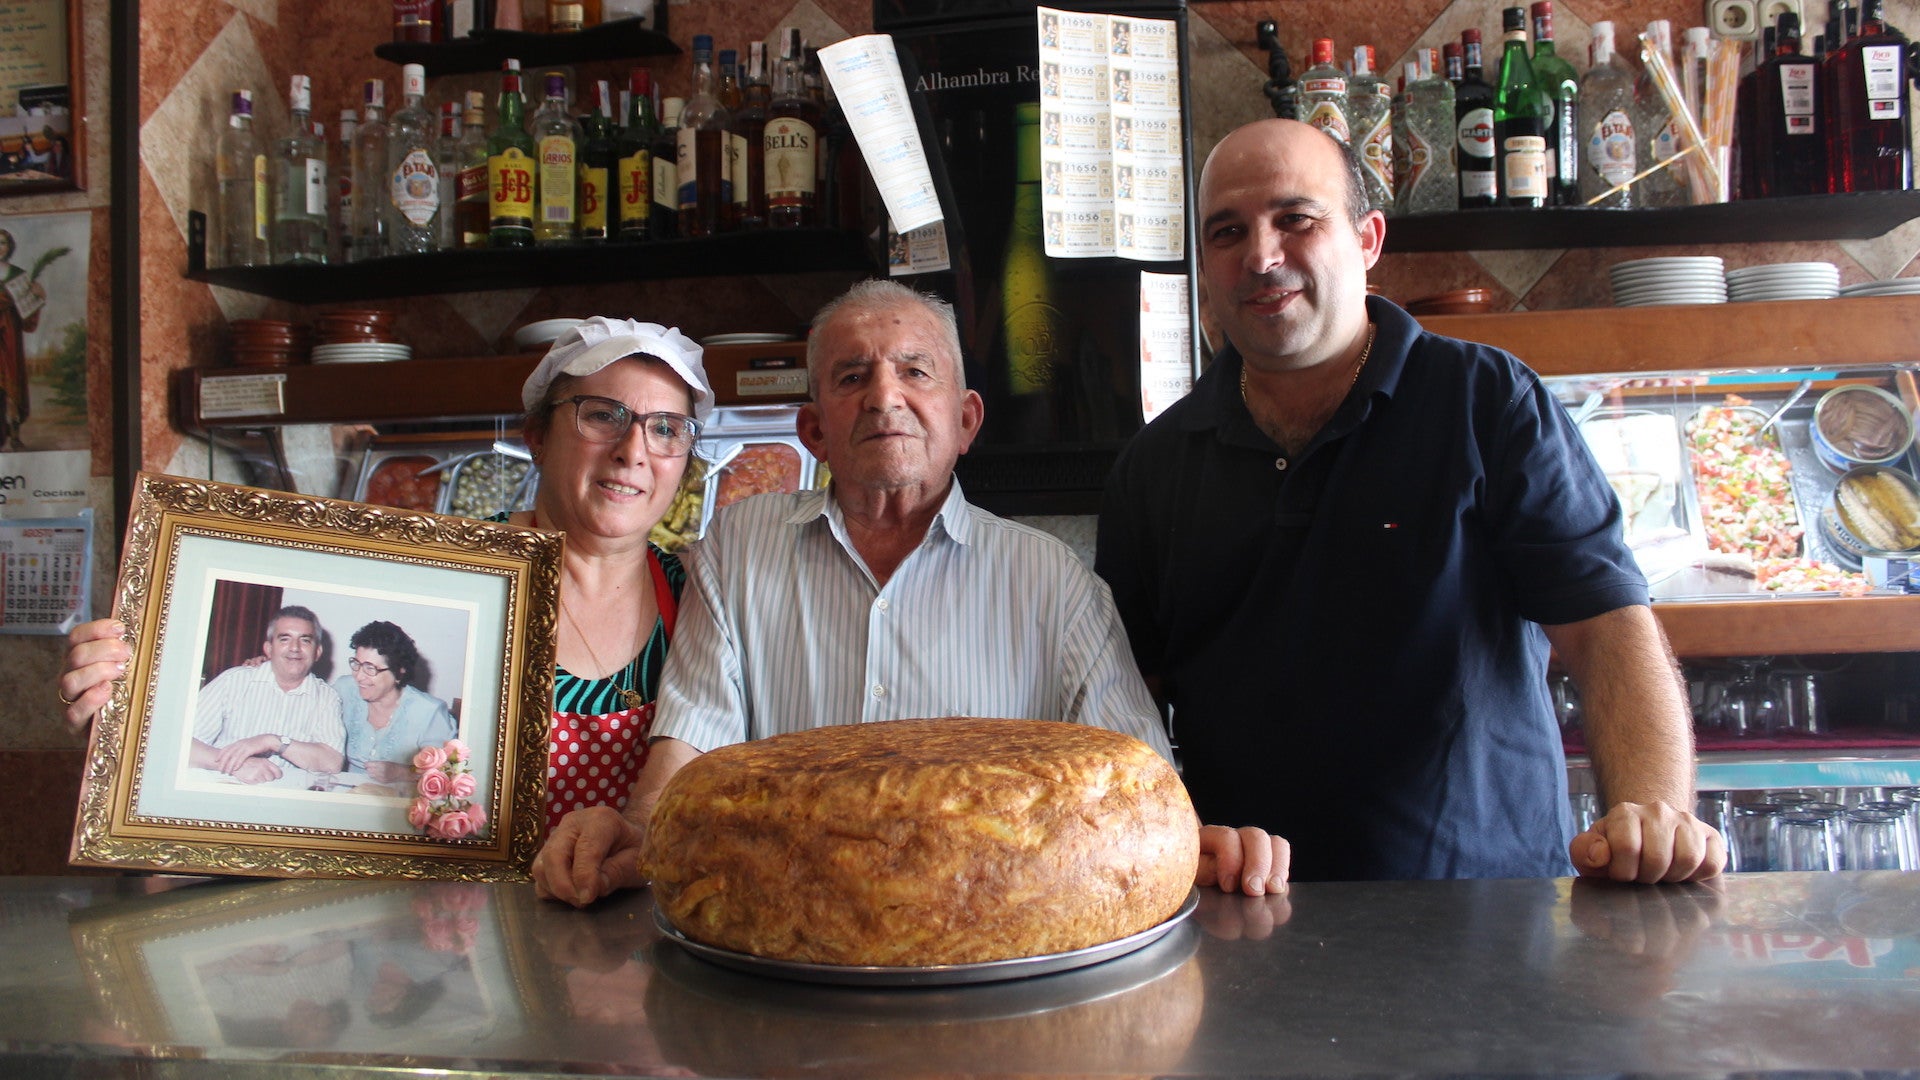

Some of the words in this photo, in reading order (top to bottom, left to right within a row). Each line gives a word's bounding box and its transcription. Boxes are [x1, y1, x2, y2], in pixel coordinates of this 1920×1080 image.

[914, 68, 1011, 92] Alhambra
[1016, 65, 1040, 83] Re
[1462, 128, 1494, 138] MARTI
[764, 133, 809, 152] BELL'S
[543, 152, 573, 165] LARIOS
[494, 168, 531, 204] J&B
[626, 170, 649, 205] J&
[0, 474, 26, 490] en
[32, 489, 86, 498] Cocinas
